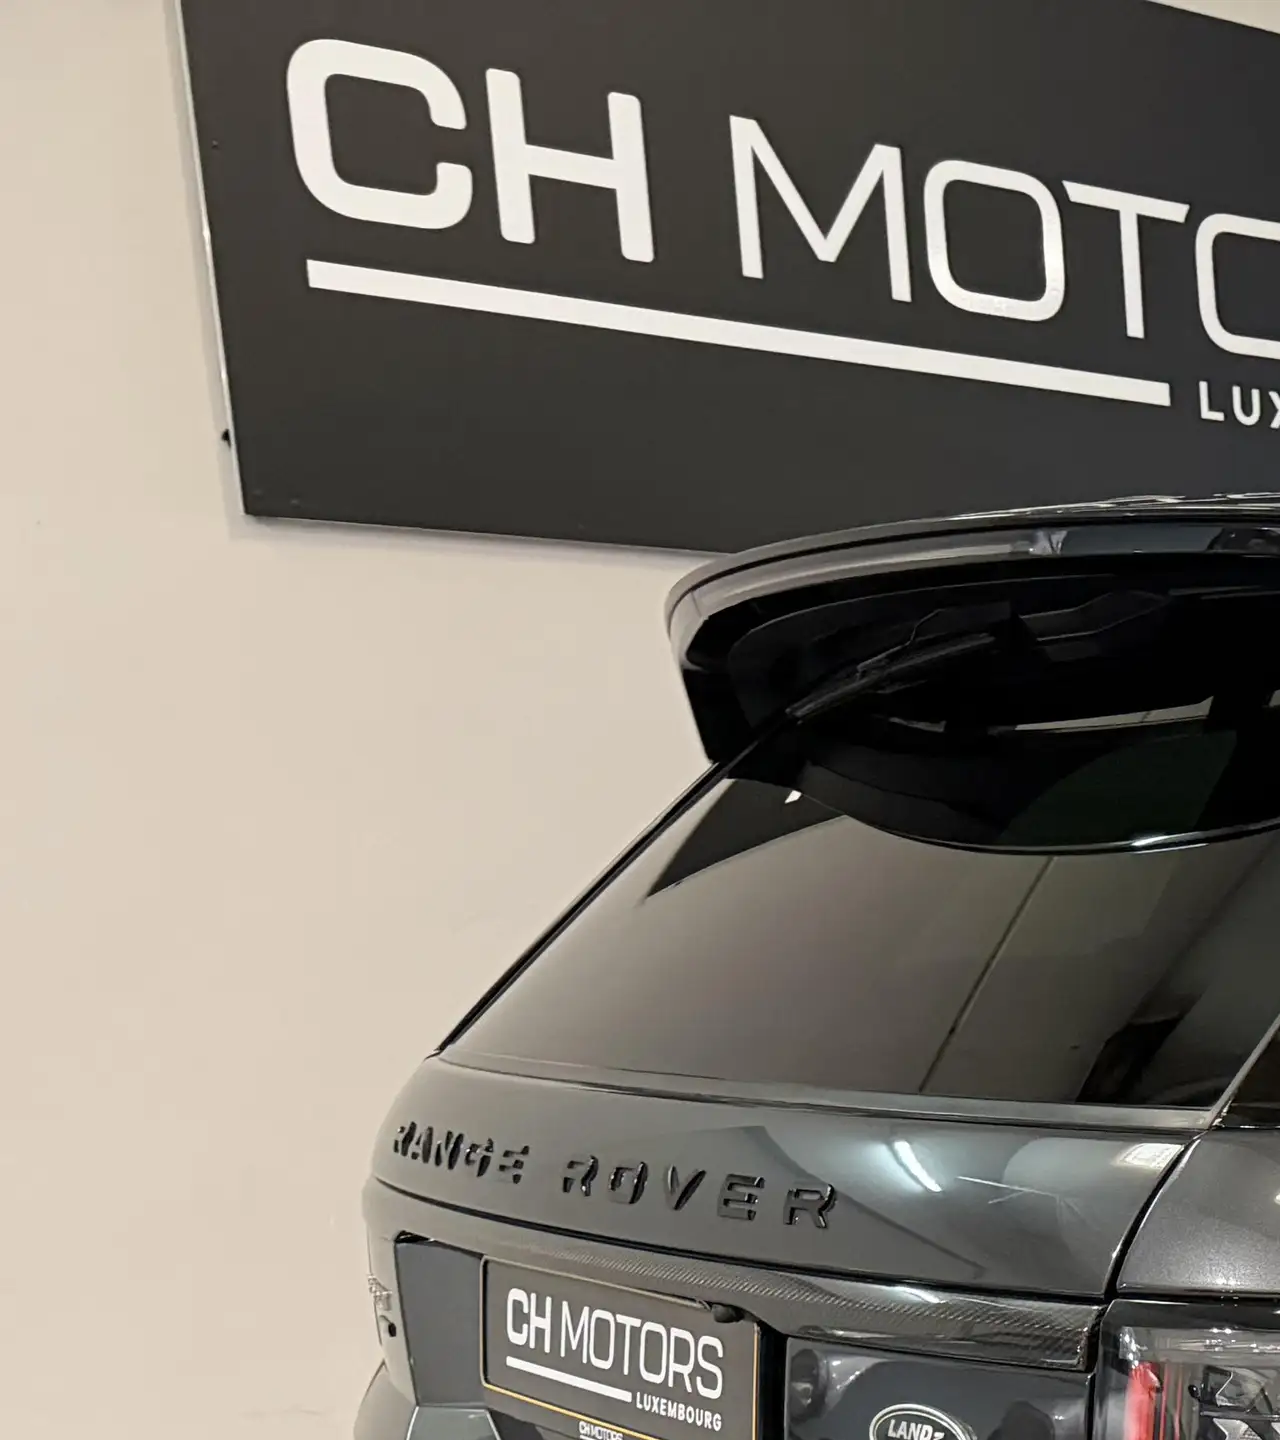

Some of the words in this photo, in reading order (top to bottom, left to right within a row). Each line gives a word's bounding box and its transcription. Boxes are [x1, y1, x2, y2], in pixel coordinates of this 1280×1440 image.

[286, 39, 654, 262] CH
[562, 1155, 836, 1229] ROVER
[506, 1288, 552, 1353] CH
[560, 1301, 723, 1400] MOTORS
[578, 1421, 590, 1436] CH
[635, 1391, 722, 1432] LUXEMBOURG
